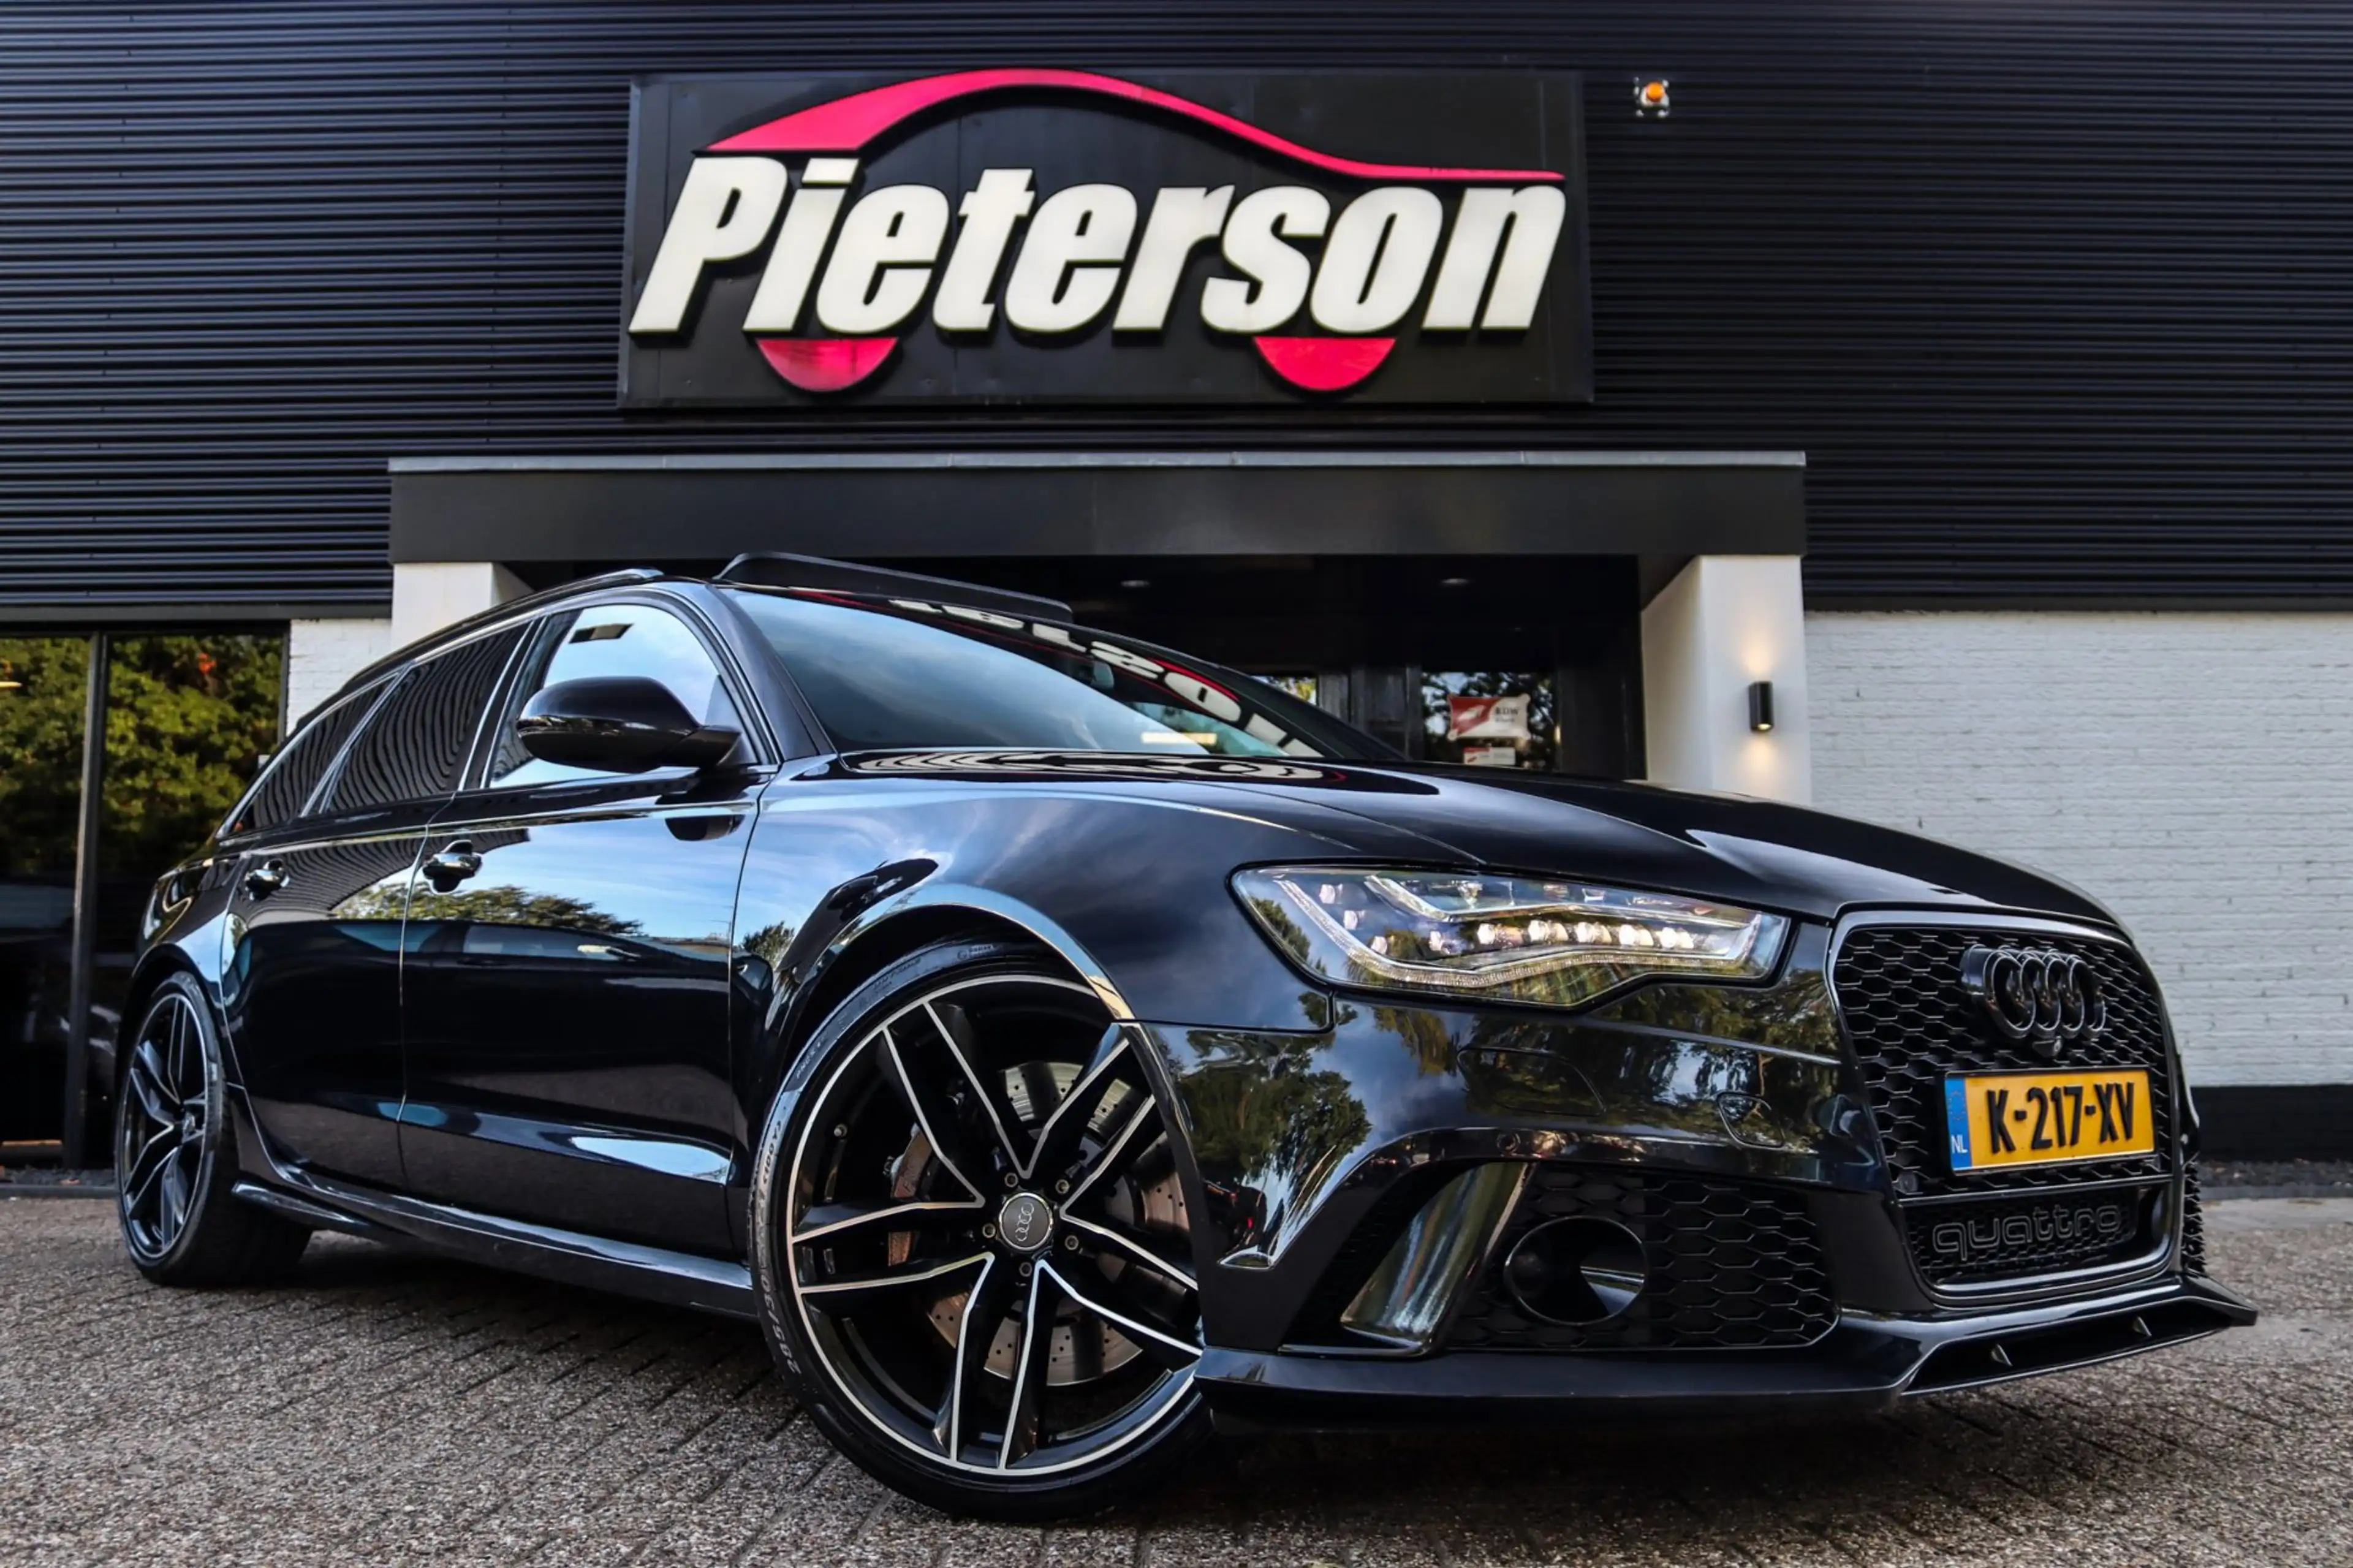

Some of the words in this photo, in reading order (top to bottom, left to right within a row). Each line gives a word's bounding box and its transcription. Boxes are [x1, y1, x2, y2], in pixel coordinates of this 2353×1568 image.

[630, 154, 1566, 335] Pieterson
[1951, 1134, 1968, 1154] NL
[1985, 1082, 2135, 1154] K-217-XV
[1933, 1203, 2124, 1261] quattro
